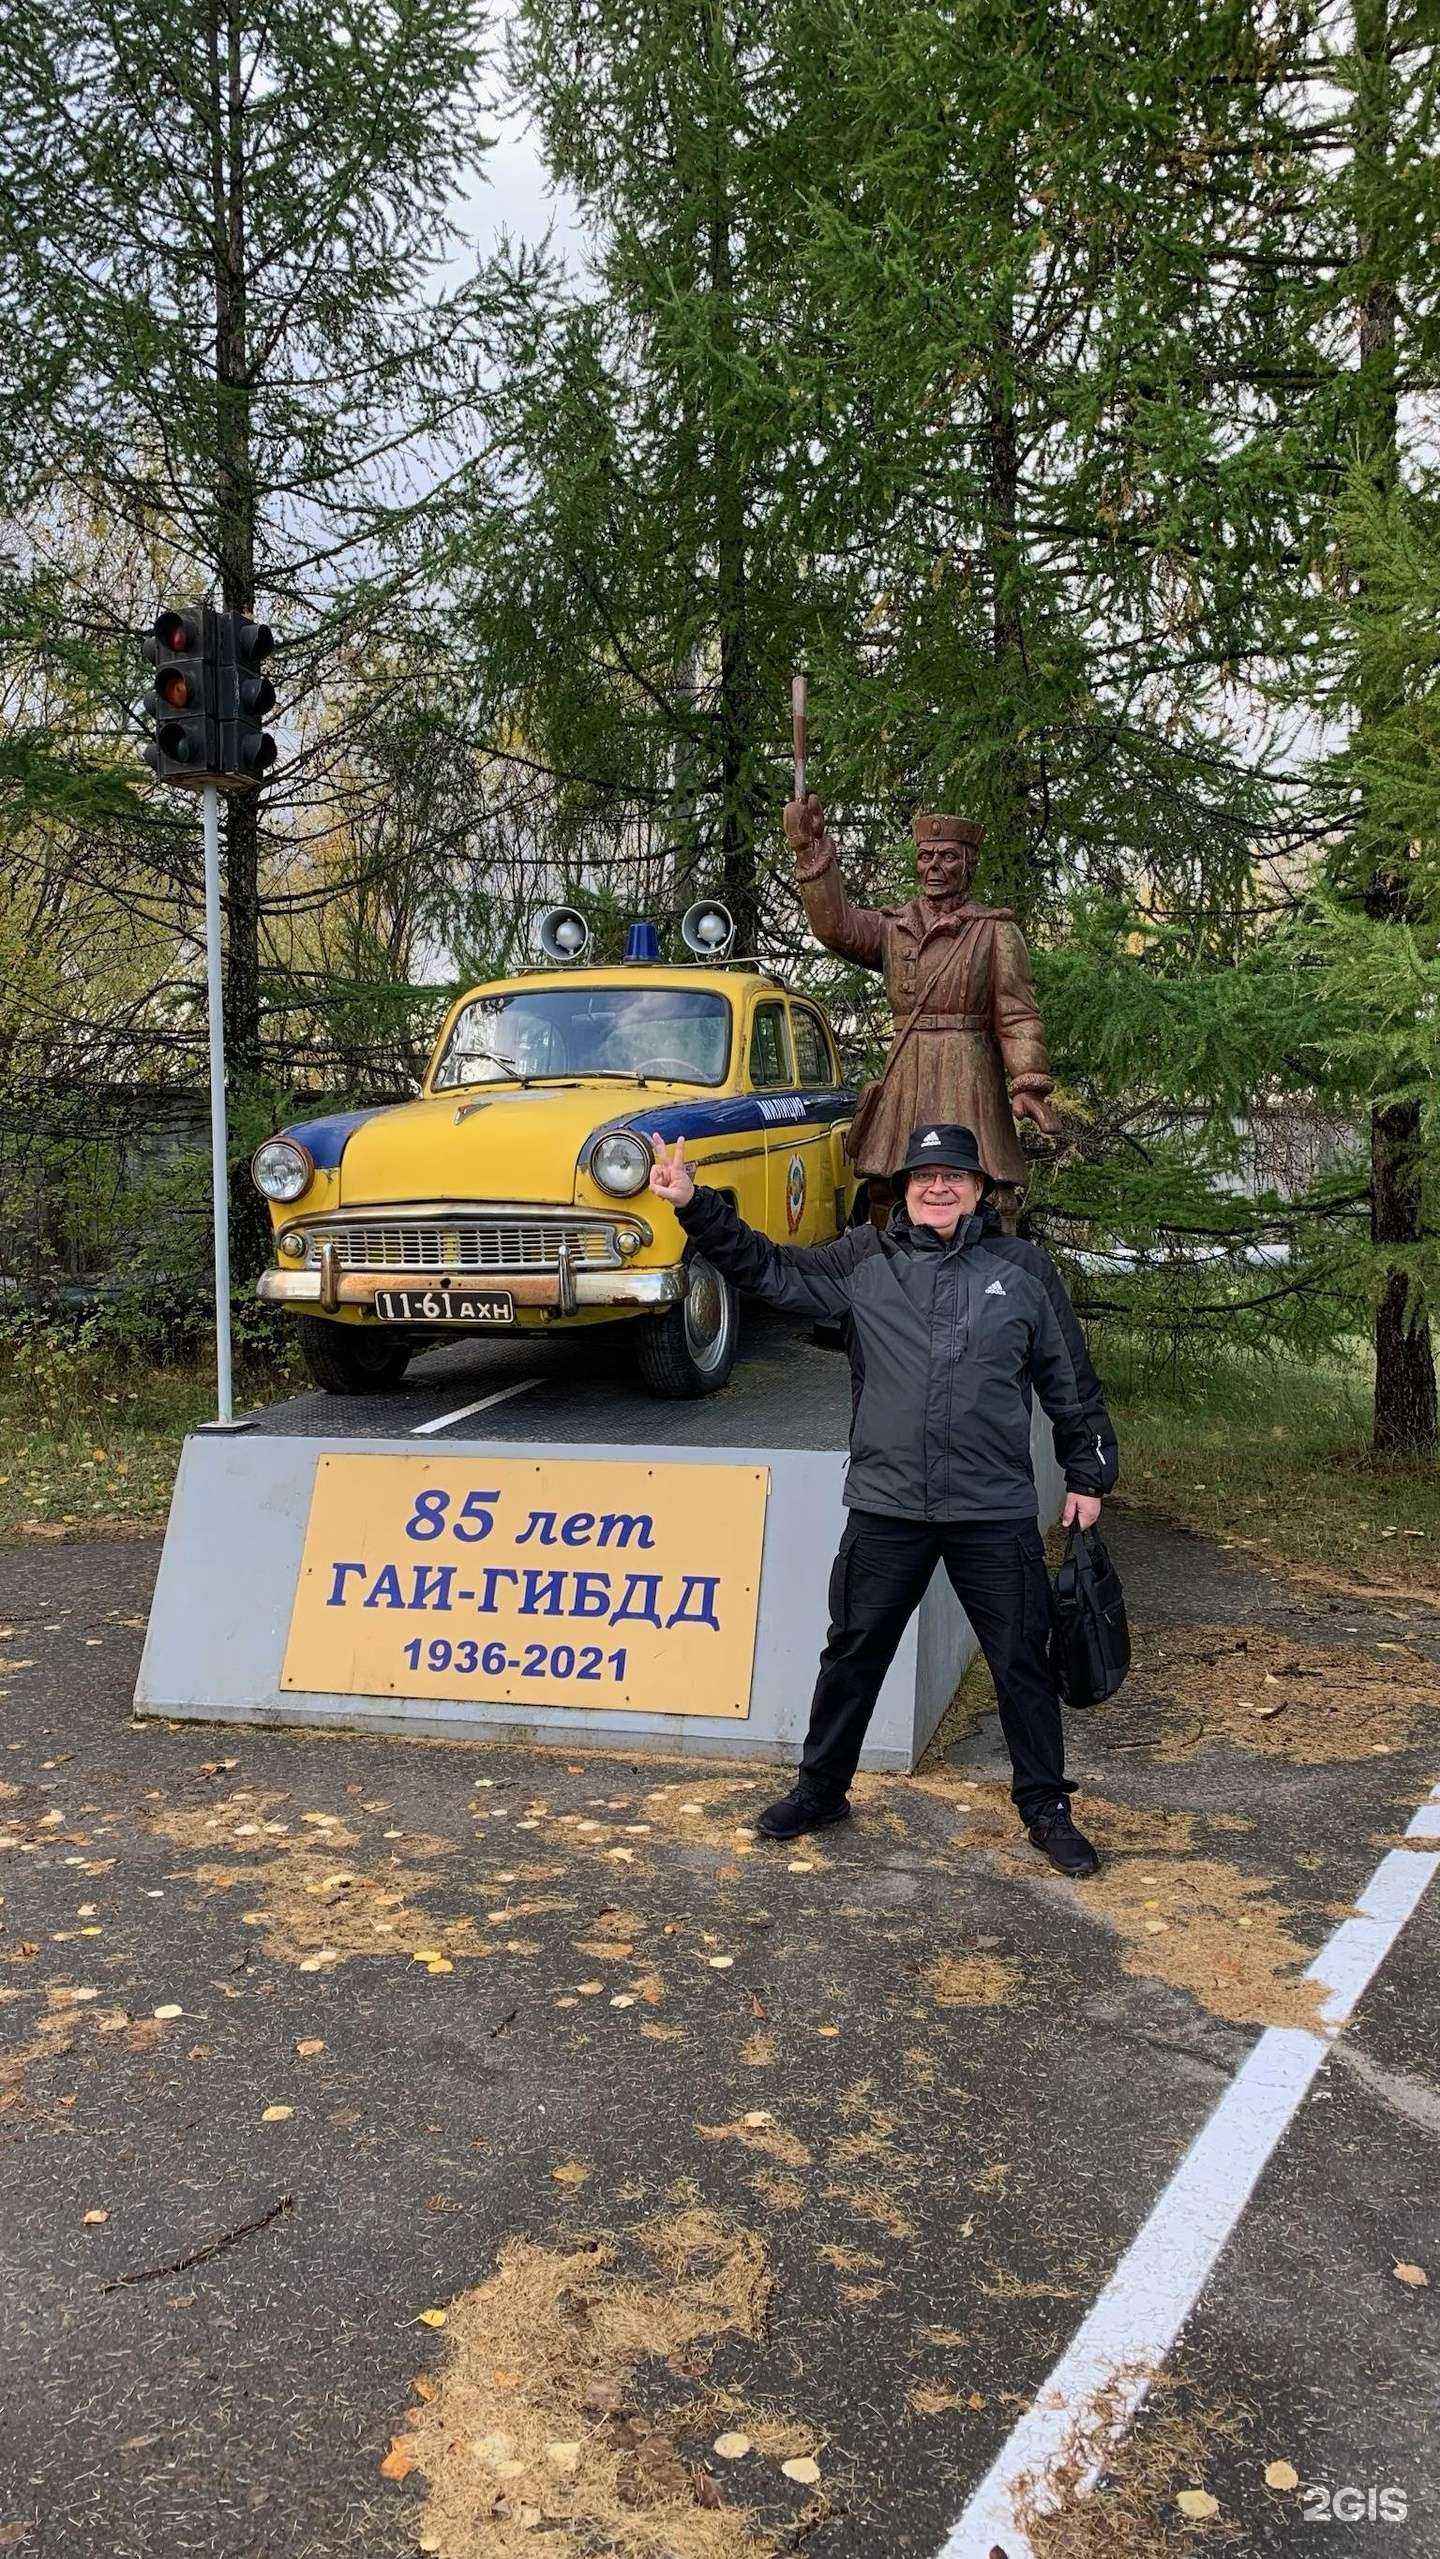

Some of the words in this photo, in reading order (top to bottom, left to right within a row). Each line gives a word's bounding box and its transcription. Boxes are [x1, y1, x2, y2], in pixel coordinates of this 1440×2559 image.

[382, 1293, 452, 1318] 11-61
[460, 1302, 508, 1319] АХН
[405, 1489, 501, 1543] 85
[515, 1512, 656, 1549] лет
[326, 1563, 722, 1632] ГАИ-ГИБДД
[403, 1638, 628, 1682] 1936-2021
